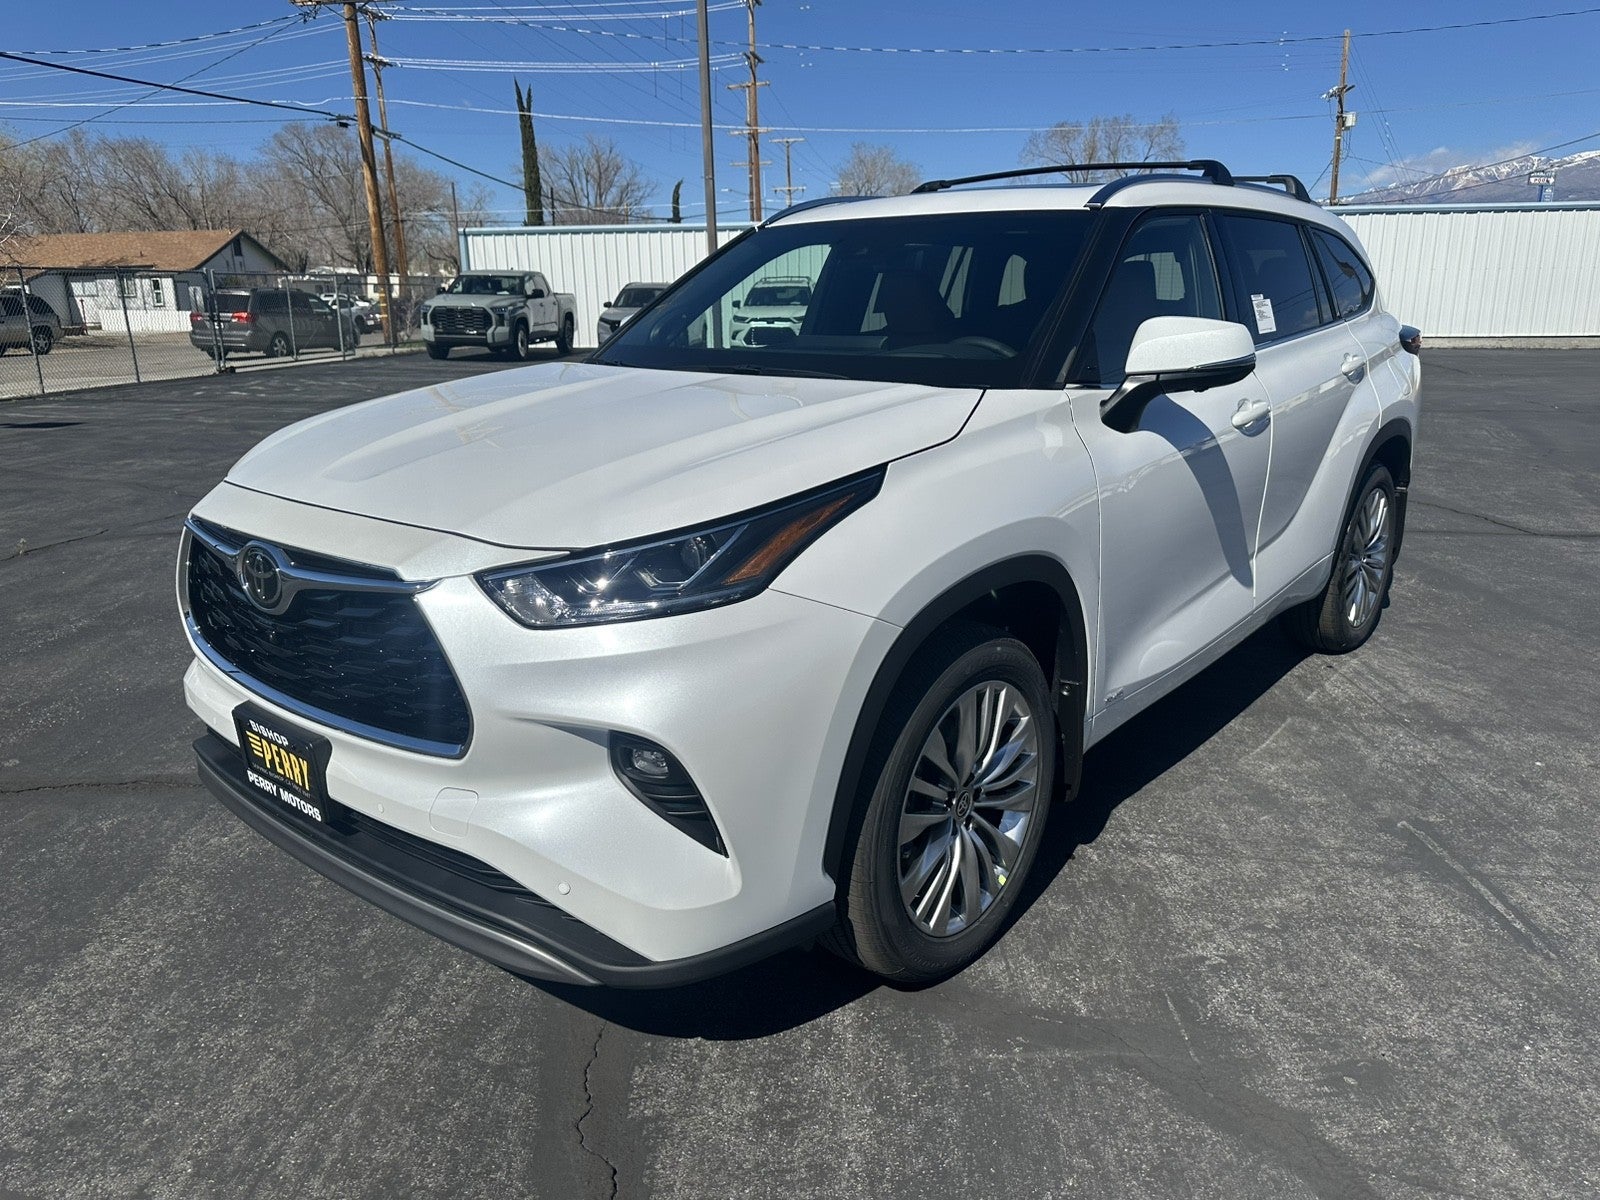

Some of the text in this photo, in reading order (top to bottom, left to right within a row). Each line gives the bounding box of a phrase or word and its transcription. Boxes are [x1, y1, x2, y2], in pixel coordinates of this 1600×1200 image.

[249, 719, 289, 746] BISHOP
[262, 738, 310, 791] PERRY
[247, 770, 277, 796] PERRY
[279, 788, 322, 822] MOTORS
